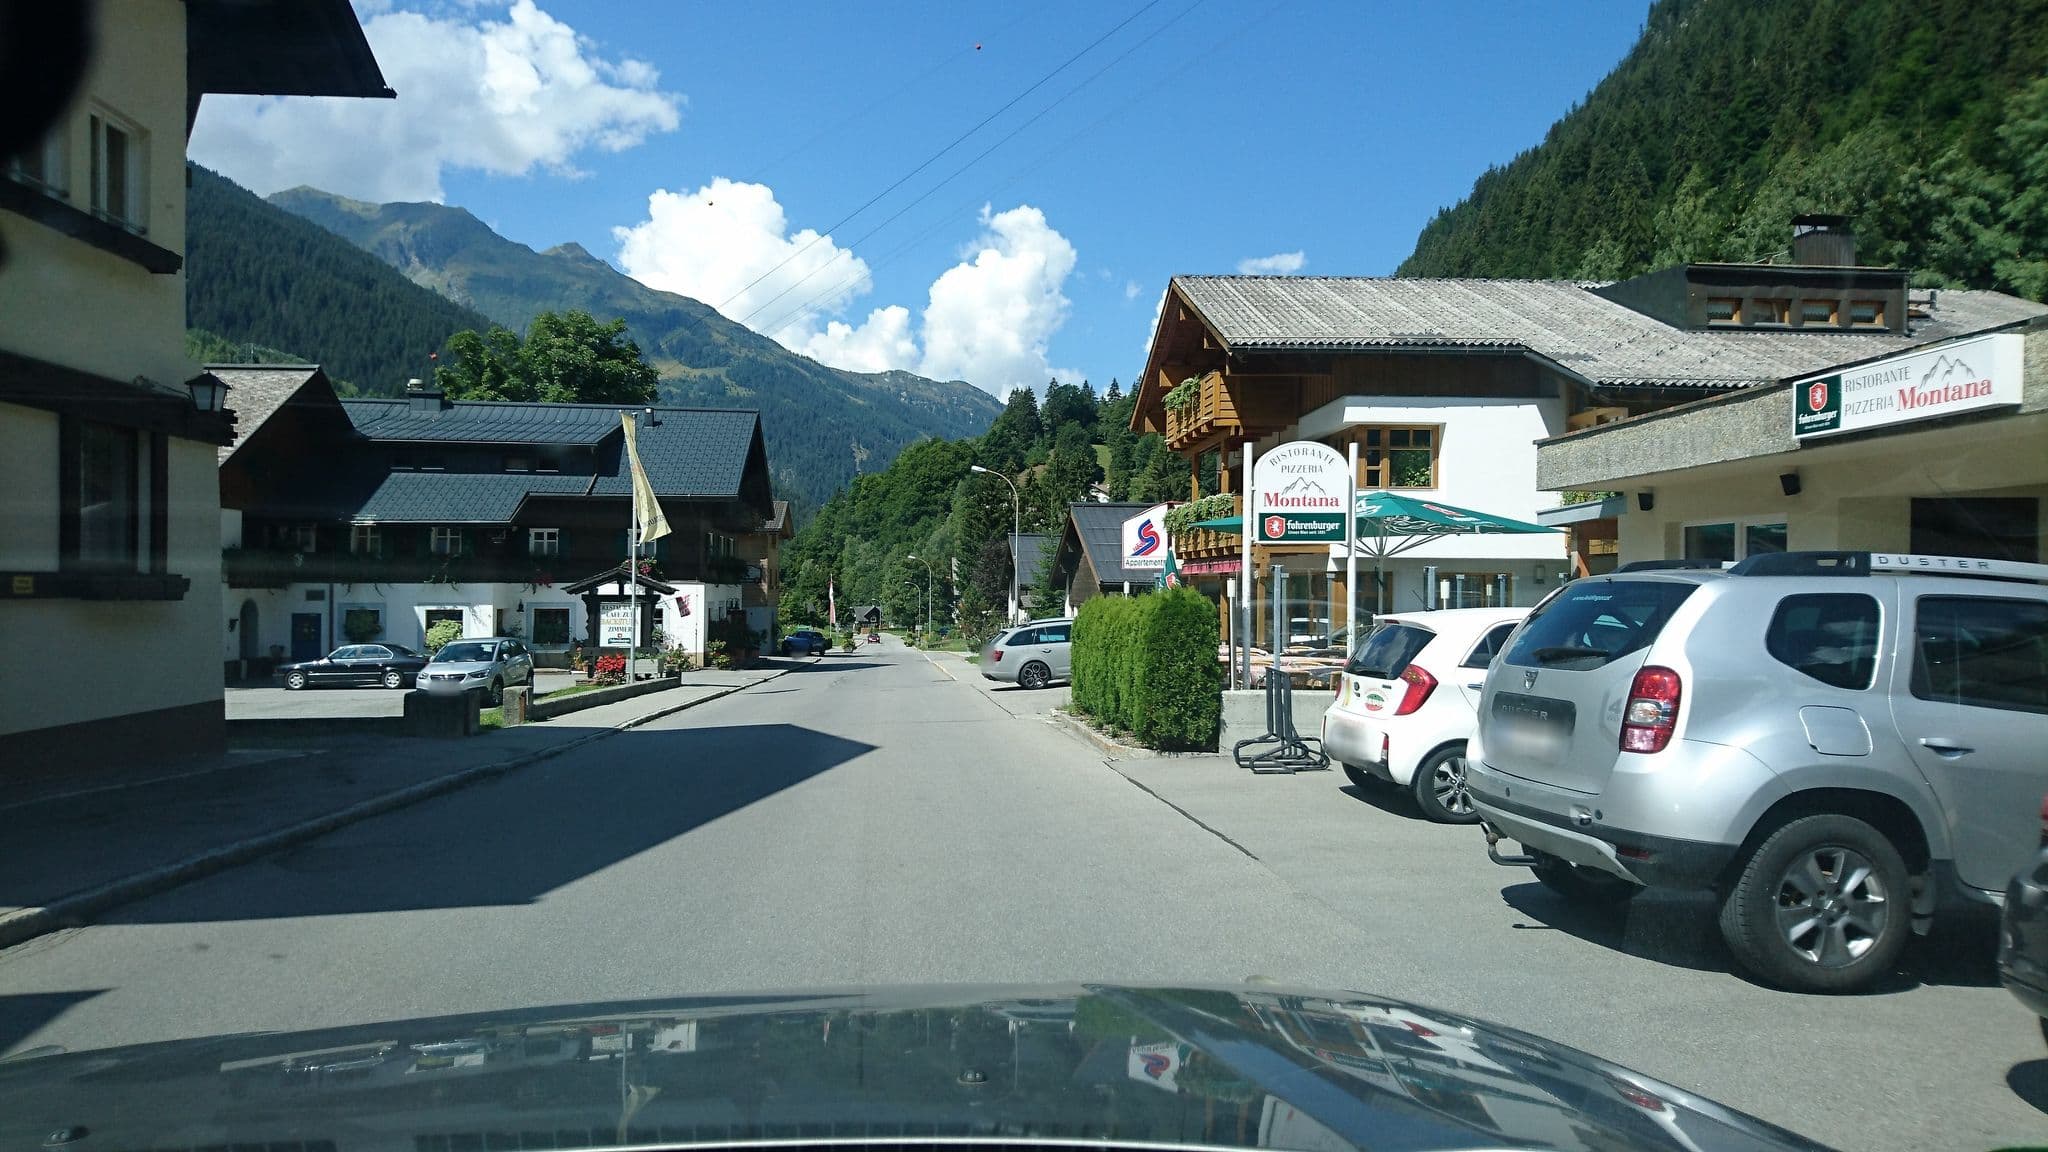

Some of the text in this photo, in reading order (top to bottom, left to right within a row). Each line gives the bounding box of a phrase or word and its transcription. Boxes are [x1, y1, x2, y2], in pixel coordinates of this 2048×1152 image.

[1844, 366, 1910, 392] RISTORANTE
[1844, 378, 1993, 417] PIZZERIA Montana
[1269, 448, 1335, 466] RISTORANTE
[1281, 465, 1323, 473] PIZZERIA
[1264, 492, 1340, 507] Montana
[1878, 556, 1990, 570] DUSTER
